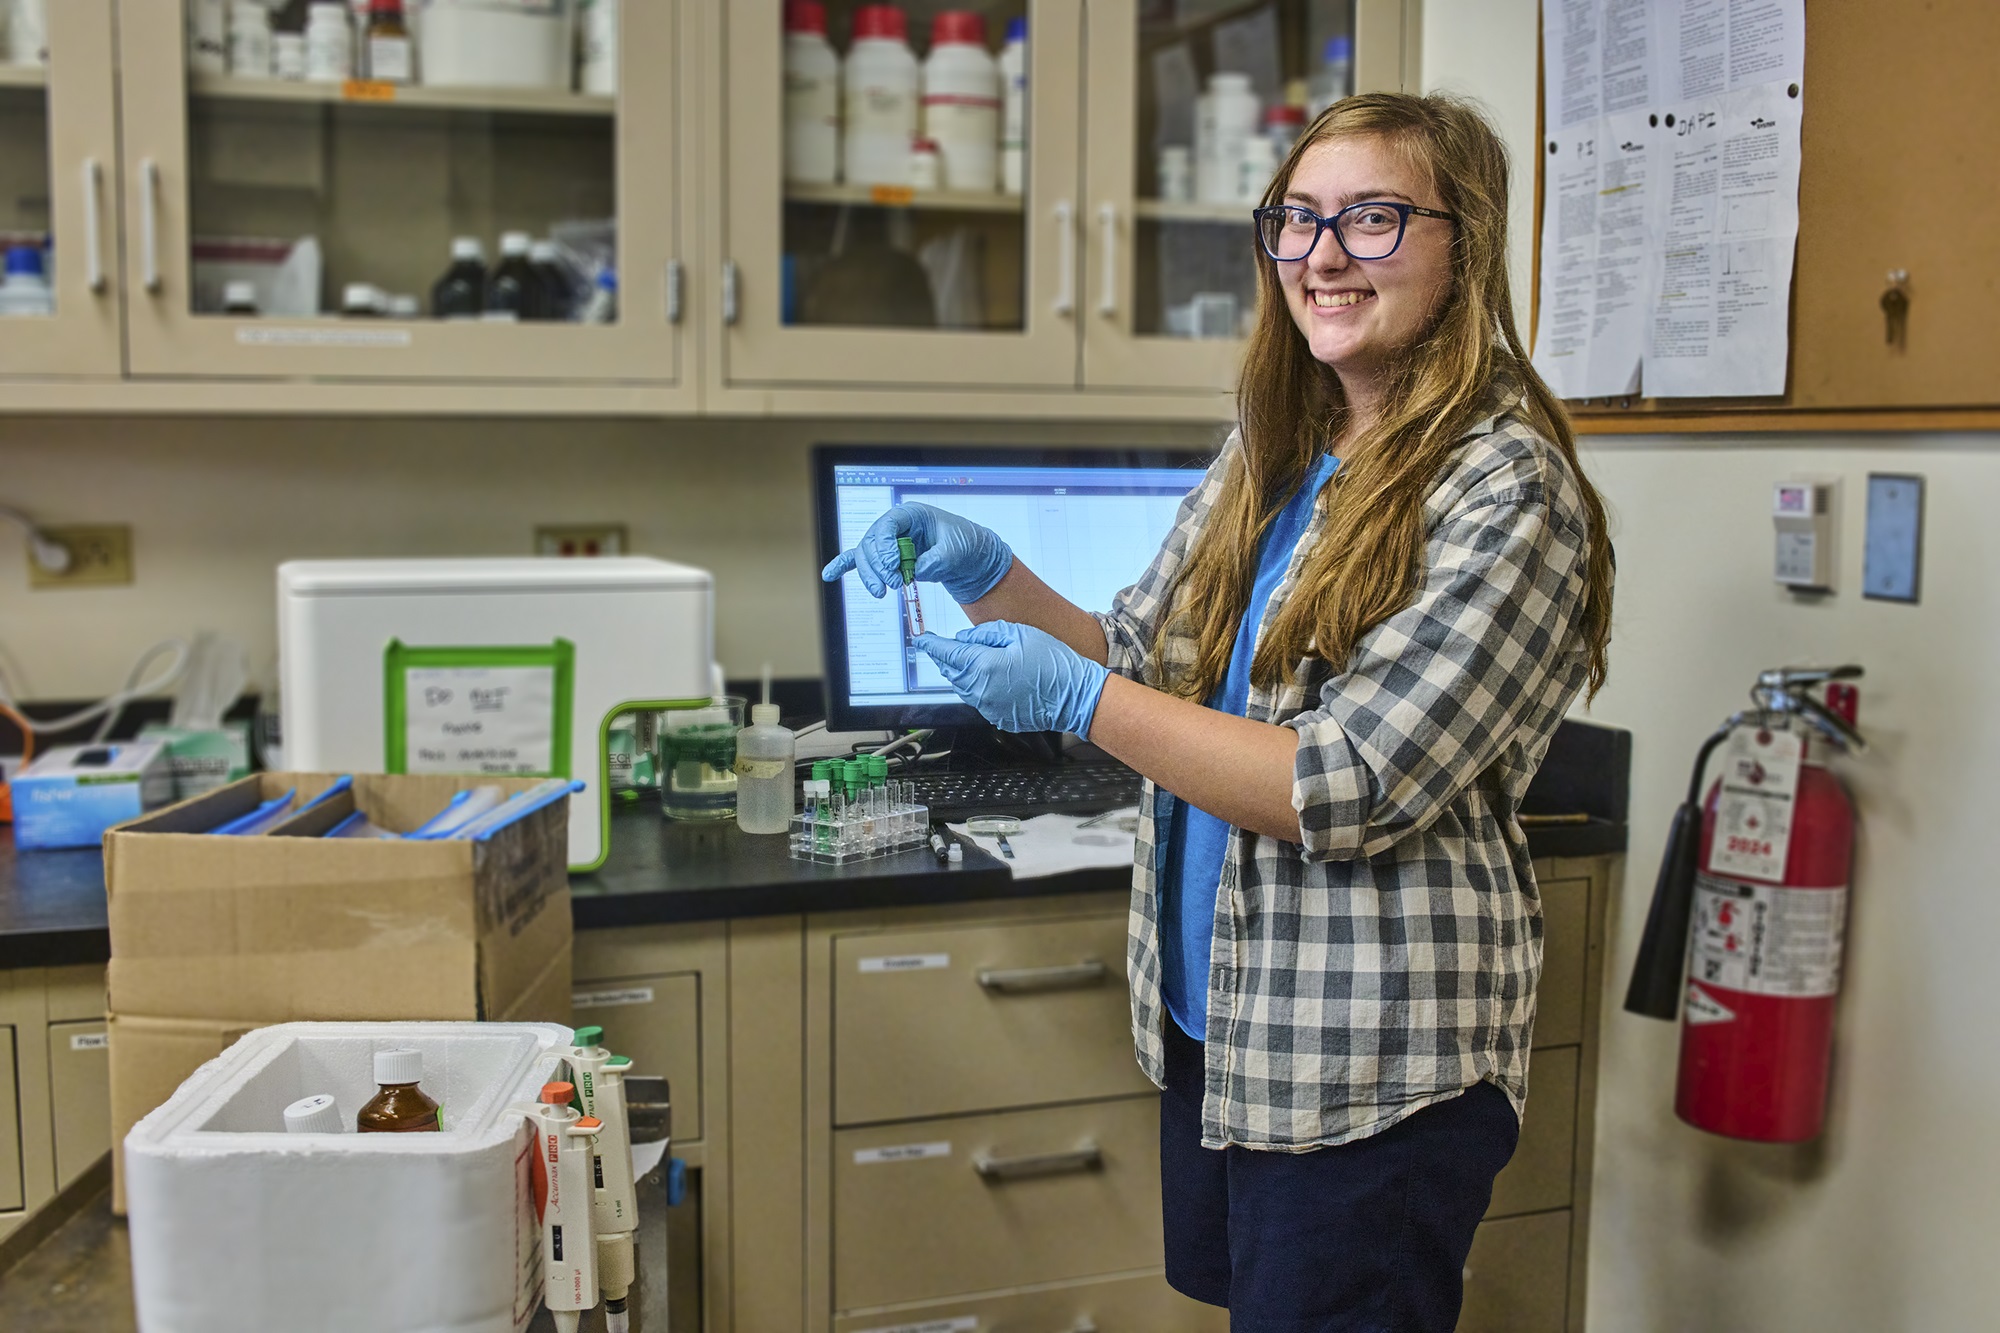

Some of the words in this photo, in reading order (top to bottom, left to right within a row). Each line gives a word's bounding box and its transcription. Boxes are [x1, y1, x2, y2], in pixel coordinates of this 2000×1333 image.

[1677, 112, 1717, 137] DAPI
[1726, 836, 1773, 856] 2024
[548, 1135, 558, 1163] PRO
[550, 1166, 560, 1214] Accumax
